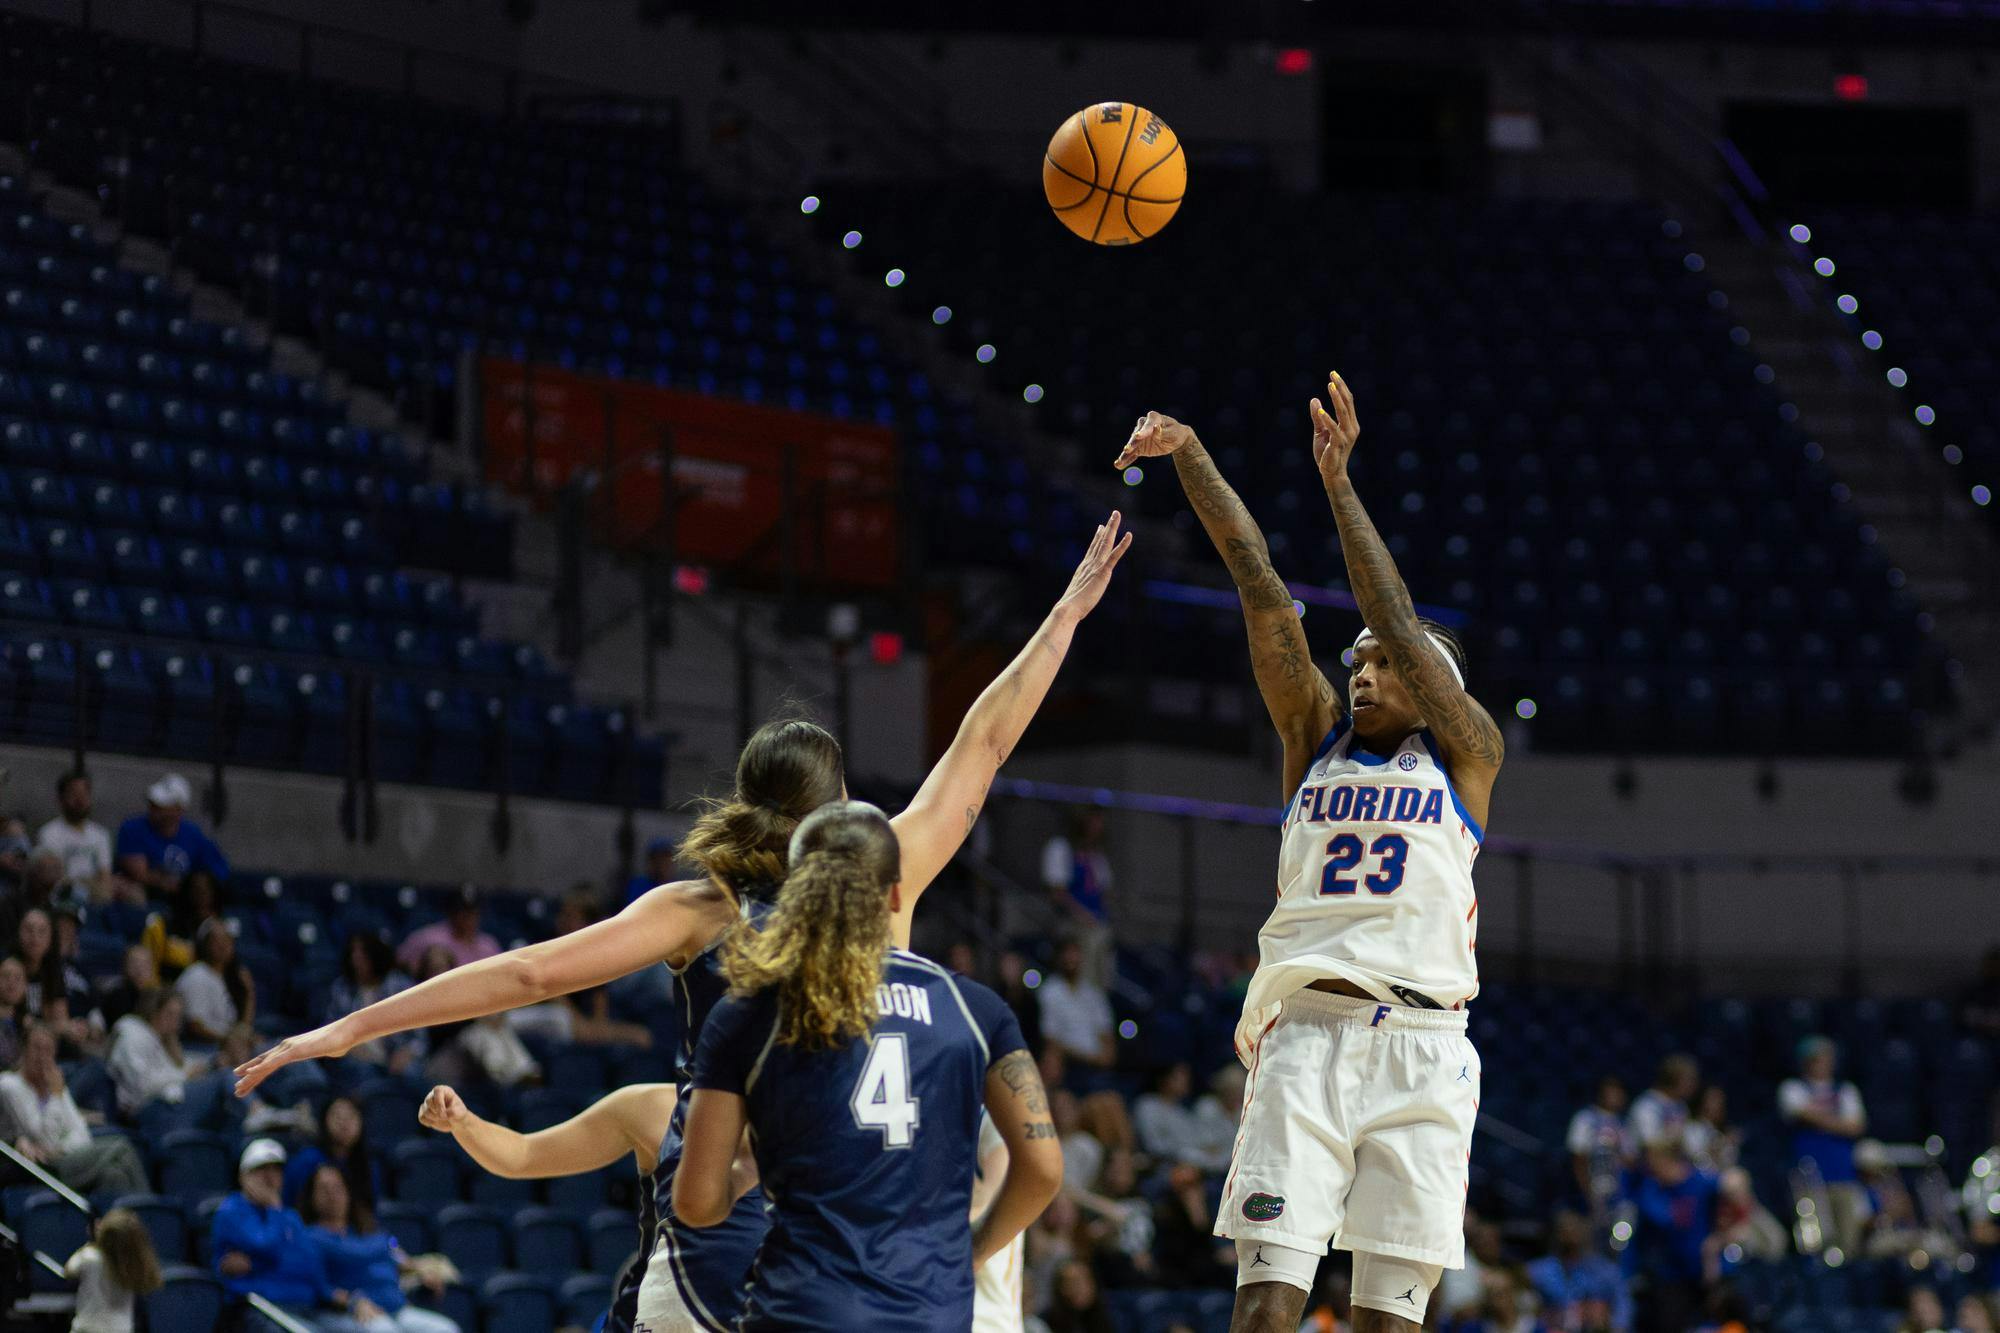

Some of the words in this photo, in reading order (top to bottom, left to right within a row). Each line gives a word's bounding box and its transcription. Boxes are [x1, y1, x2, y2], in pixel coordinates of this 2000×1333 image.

[1398, 753, 1417, 770] SEC
[1295, 785, 1444, 824] FLORIDA
[1319, 832, 1410, 896] 23
[876, 982, 933, 1026] DON
[1368, 1004, 1393, 1028] F
[849, 1032, 921, 1150] 4
